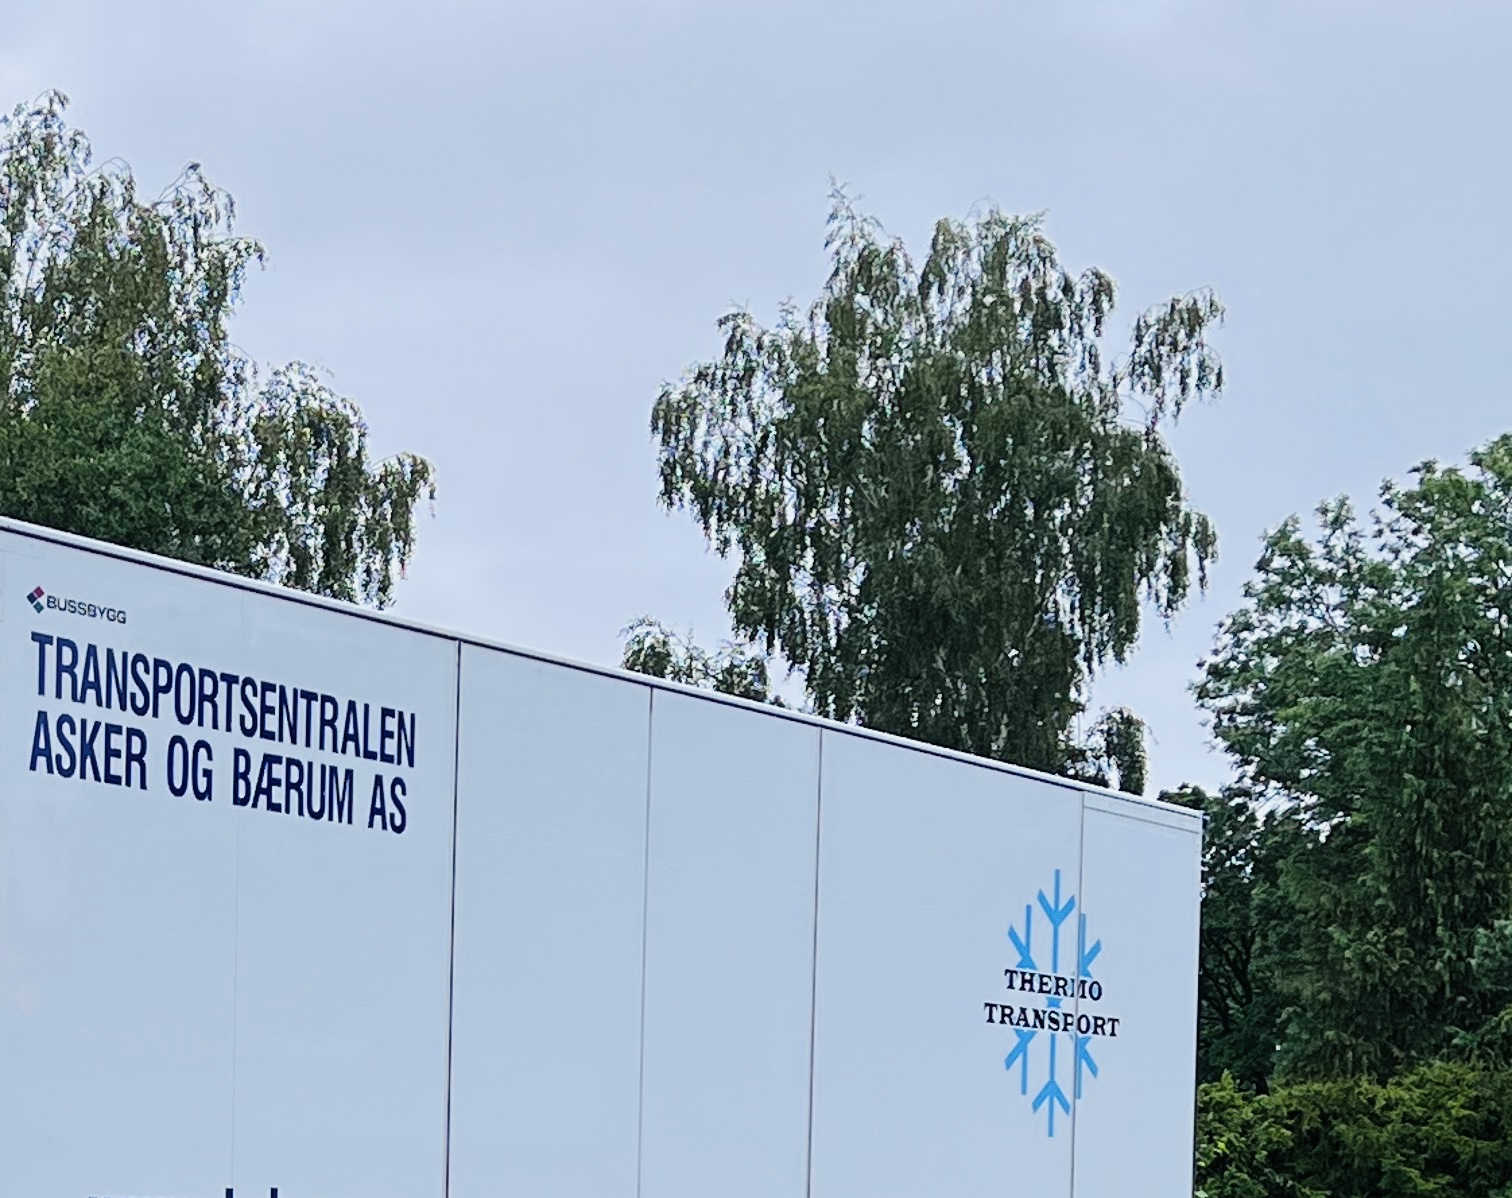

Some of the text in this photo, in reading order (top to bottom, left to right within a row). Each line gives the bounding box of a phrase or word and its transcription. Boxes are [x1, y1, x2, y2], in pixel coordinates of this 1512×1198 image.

[46, 595, 127, 625] BUSSBYGG
[30, 631, 416, 768] TRANSPORTSENTRALEN
[29, 710, 407, 834] ASKER OG BÆRUM AS
[1004, 969, 1103, 1001] THERMO
[984, 1002, 1120, 1037] TRANSPORT
